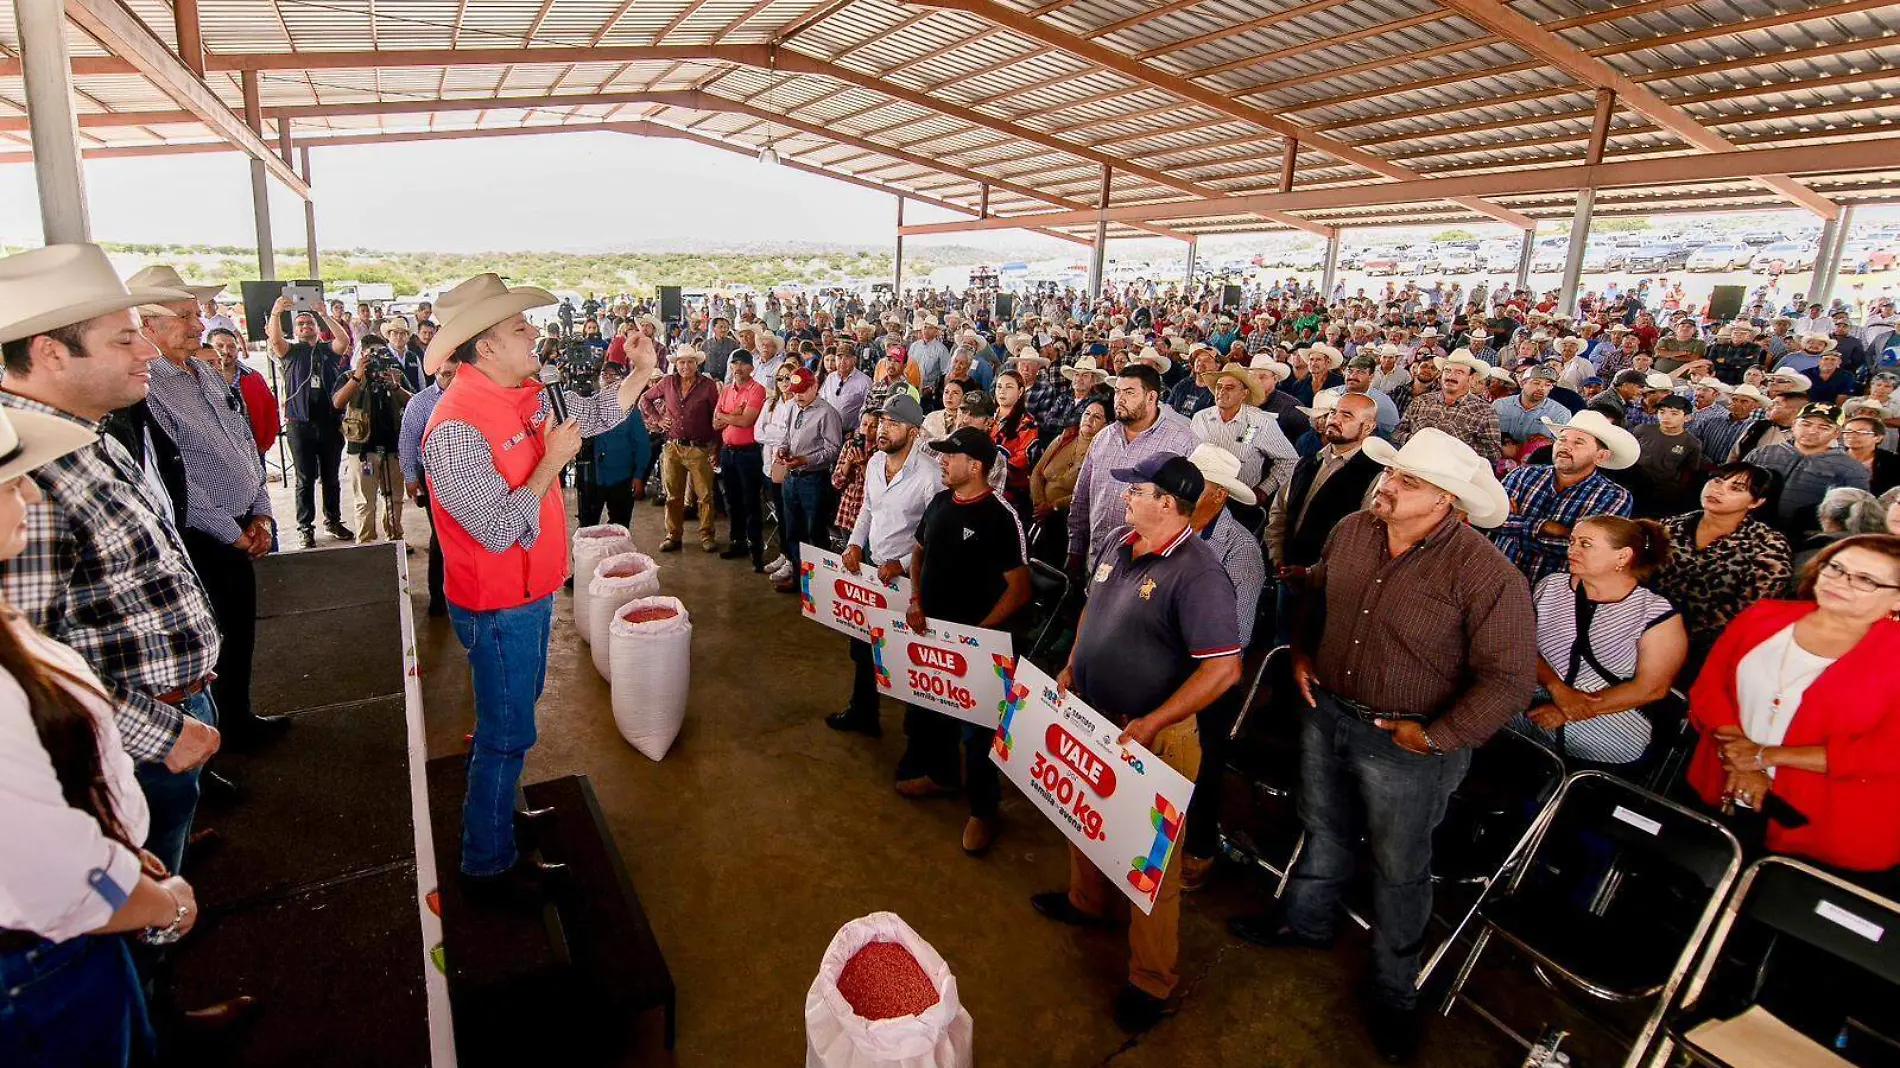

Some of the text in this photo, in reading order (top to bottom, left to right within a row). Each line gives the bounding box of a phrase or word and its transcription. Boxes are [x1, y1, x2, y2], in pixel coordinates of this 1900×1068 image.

[832, 600, 866, 626] 300
[843, 582, 876, 608] VALE
[917, 647, 956, 670] VALE
[907, 668, 977, 710] 300 kg.
[1060, 733, 1104, 786] VALE
[1030, 750, 1074, 805] 300
[1072, 790, 1106, 842] kg.
[1030, 779, 1083, 832] semilla avena
